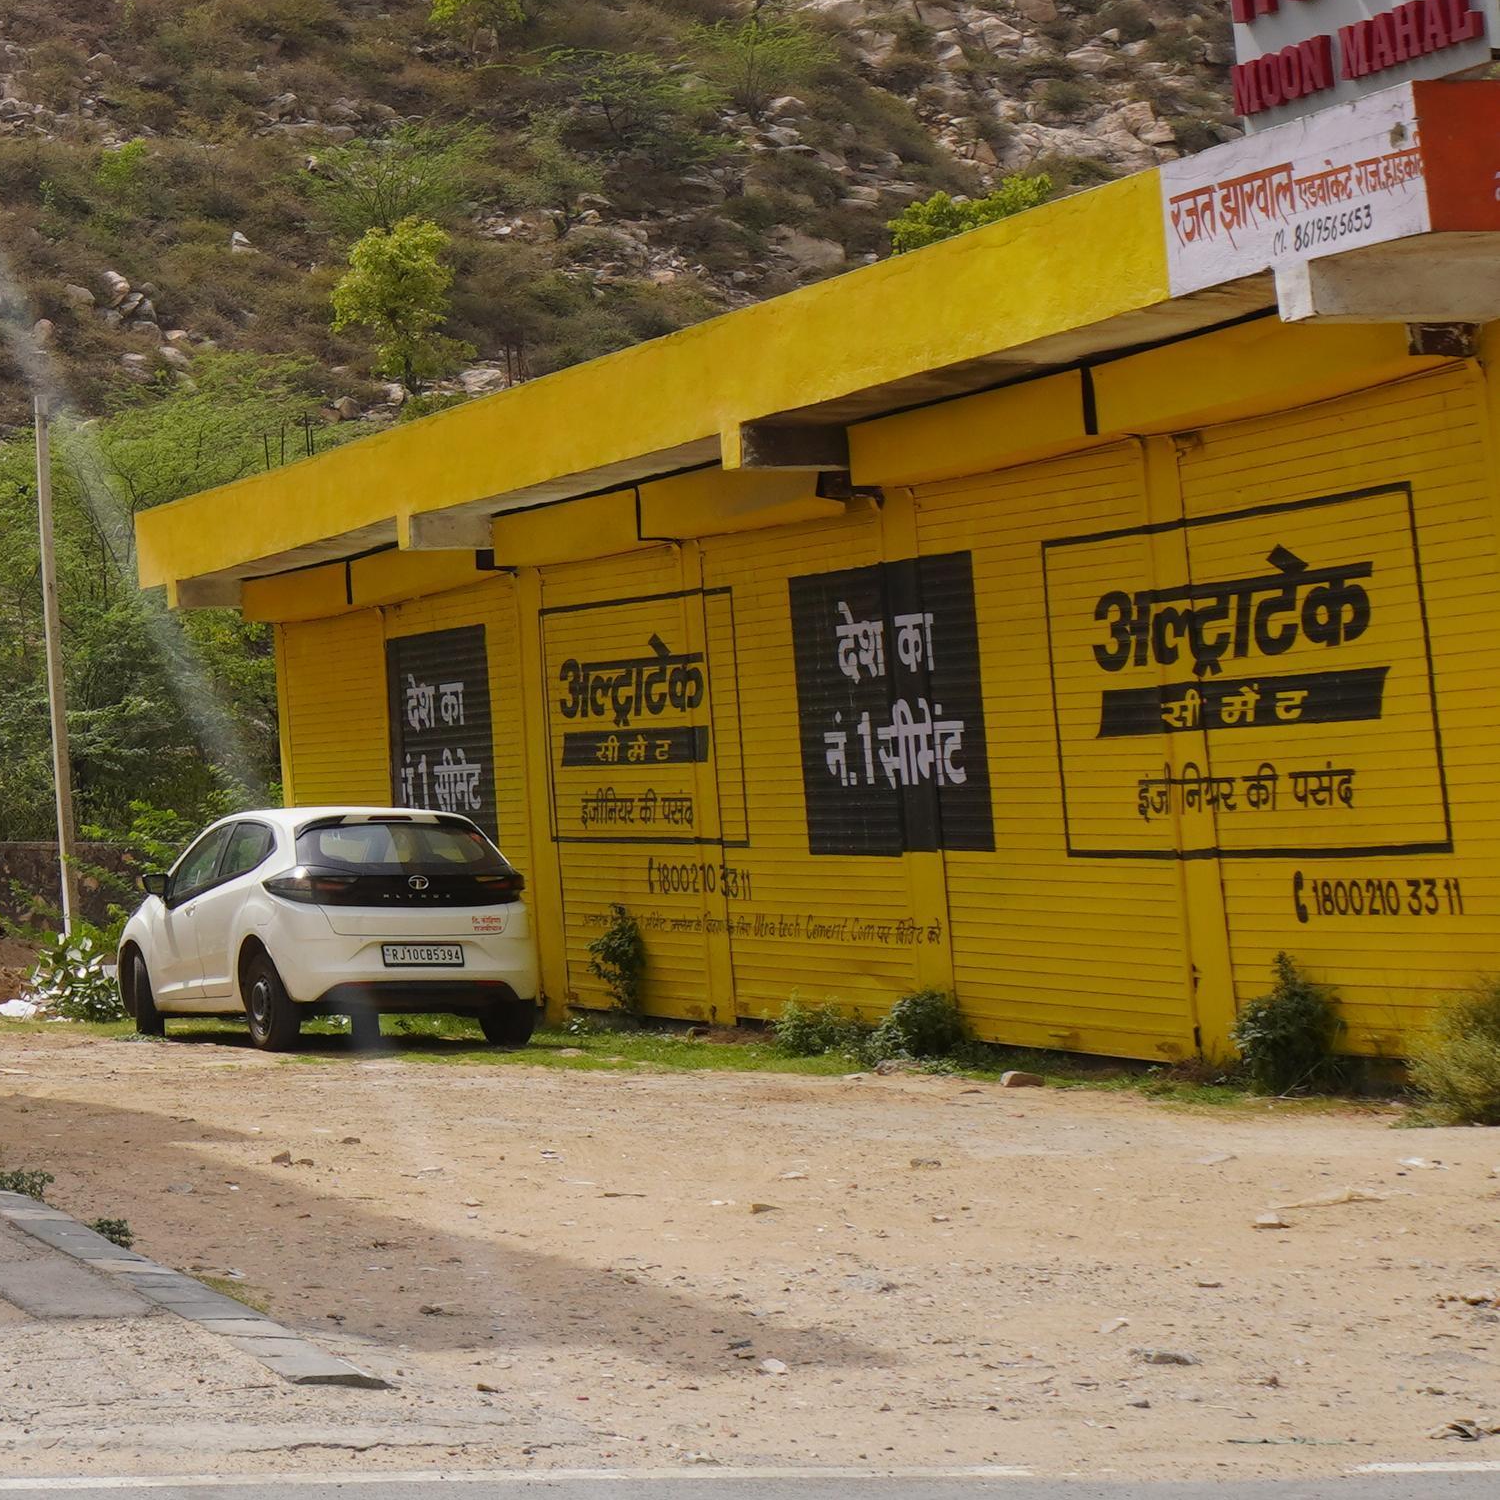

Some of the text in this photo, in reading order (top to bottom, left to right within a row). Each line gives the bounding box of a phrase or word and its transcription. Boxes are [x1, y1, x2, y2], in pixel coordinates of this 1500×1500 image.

[1231, 34, 1334, 117] MOON
[1169, 184, 1217, 248] रजत
[1216, 162, 1297, 250] झारवाल
[1294, 204, 1372, 251] 8619565653
[835, 601, 934, 684] देश का
[406, 674, 465, 733] देश का
[638, 788, 657, 824] की
[1243, 762, 1279, 811] की
[1288, 761, 1355, 809] पसंद
[392, 948, 460, 961] RJ10CB5394
